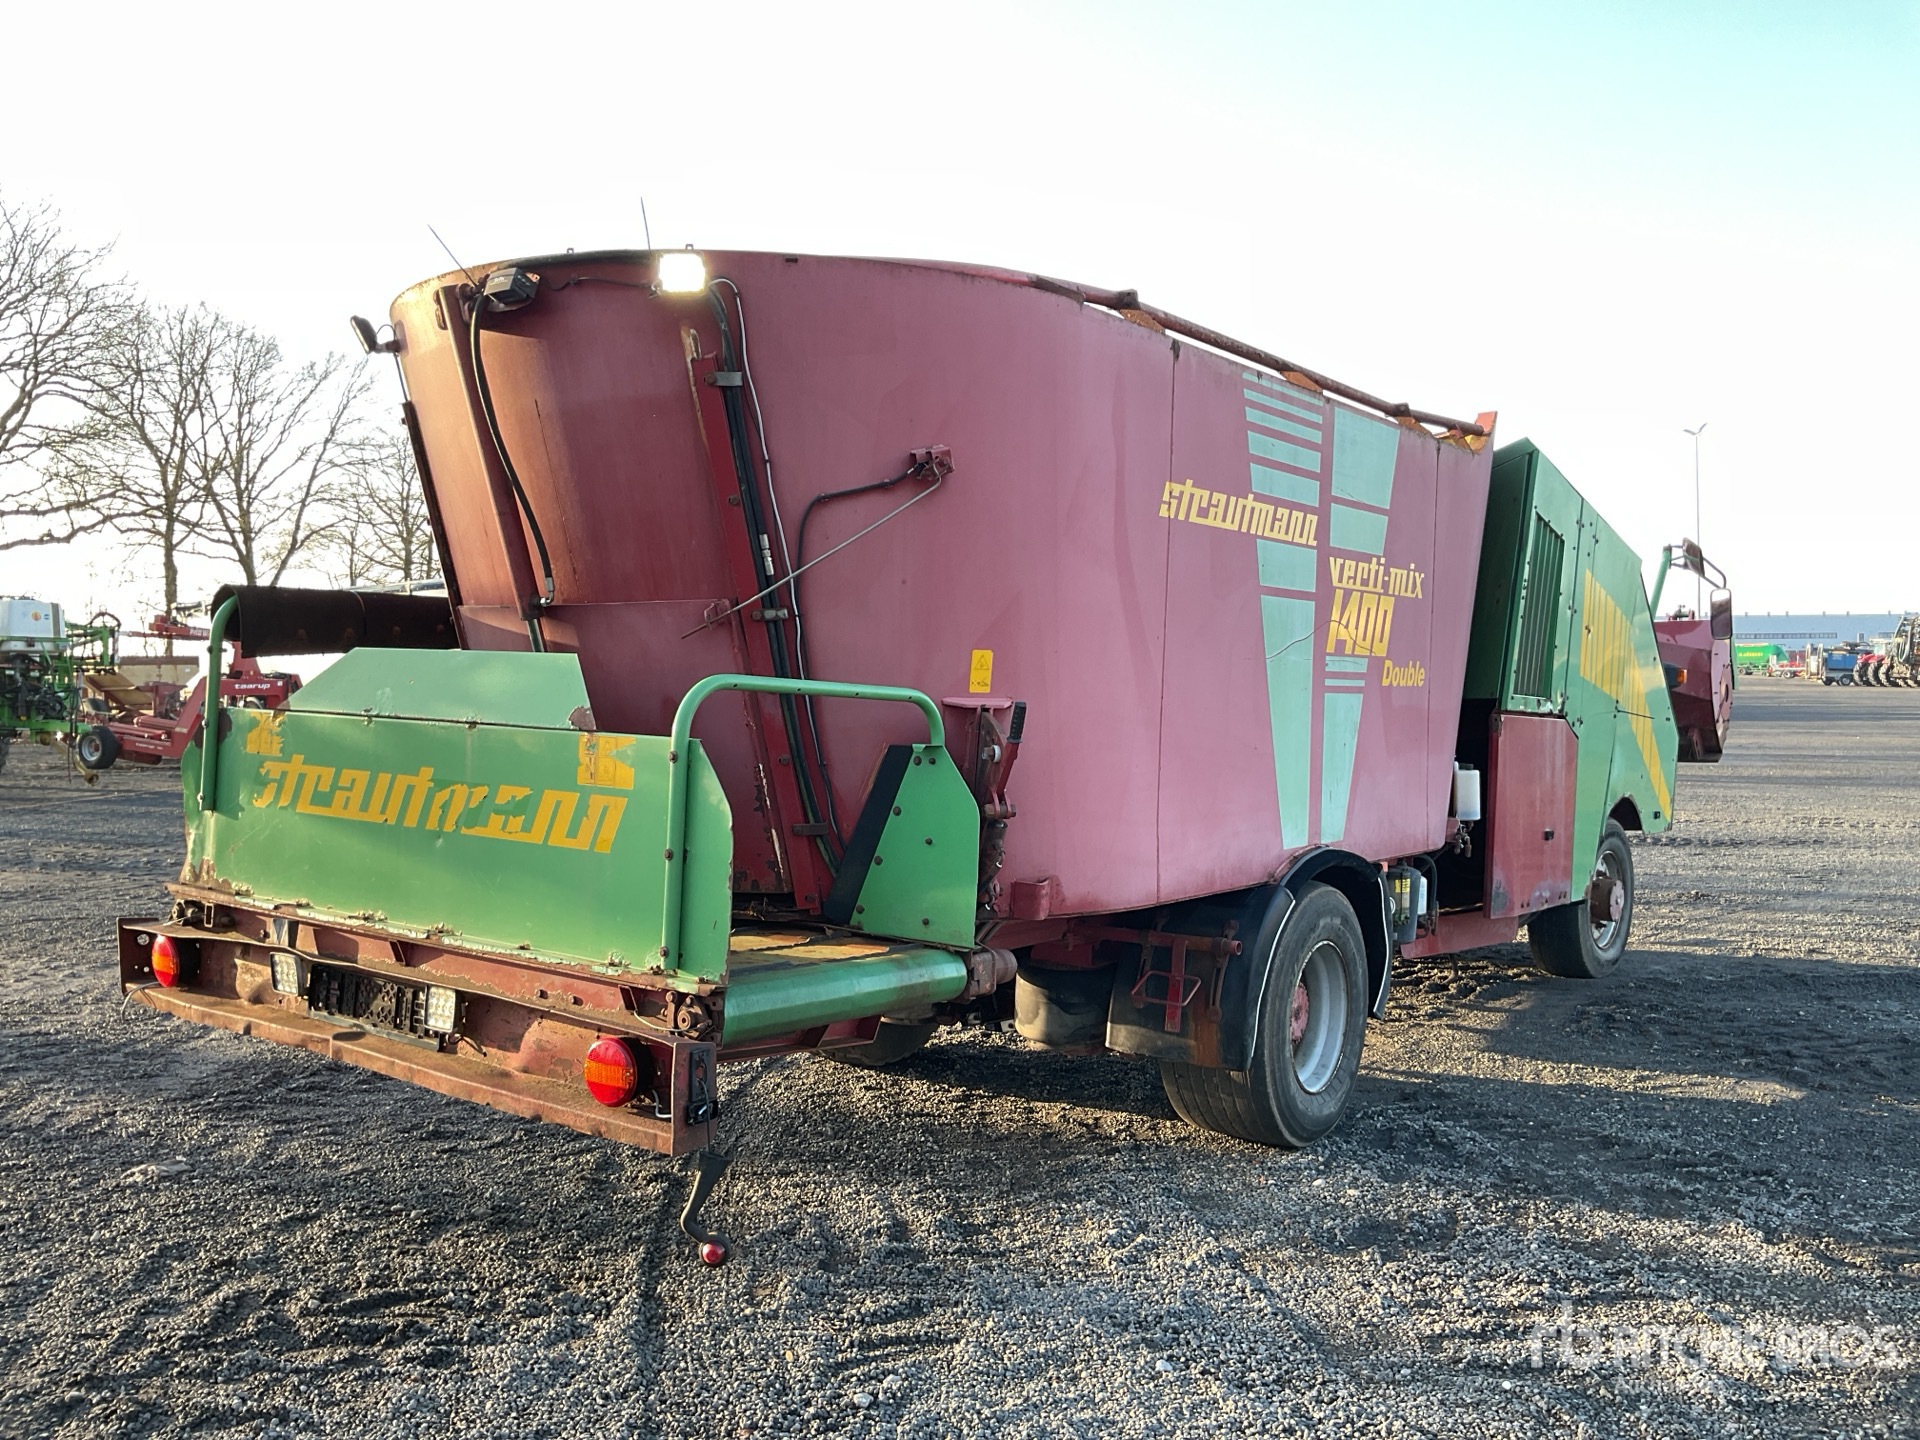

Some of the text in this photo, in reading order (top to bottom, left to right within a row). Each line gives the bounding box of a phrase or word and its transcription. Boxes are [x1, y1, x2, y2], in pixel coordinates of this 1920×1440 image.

[1158, 479, 1318, 546] strautmann
[1329, 555, 1425, 599] verti-mix
[1326, 588, 1395, 656] 1400
[1381, 659, 1425, 687] Double
